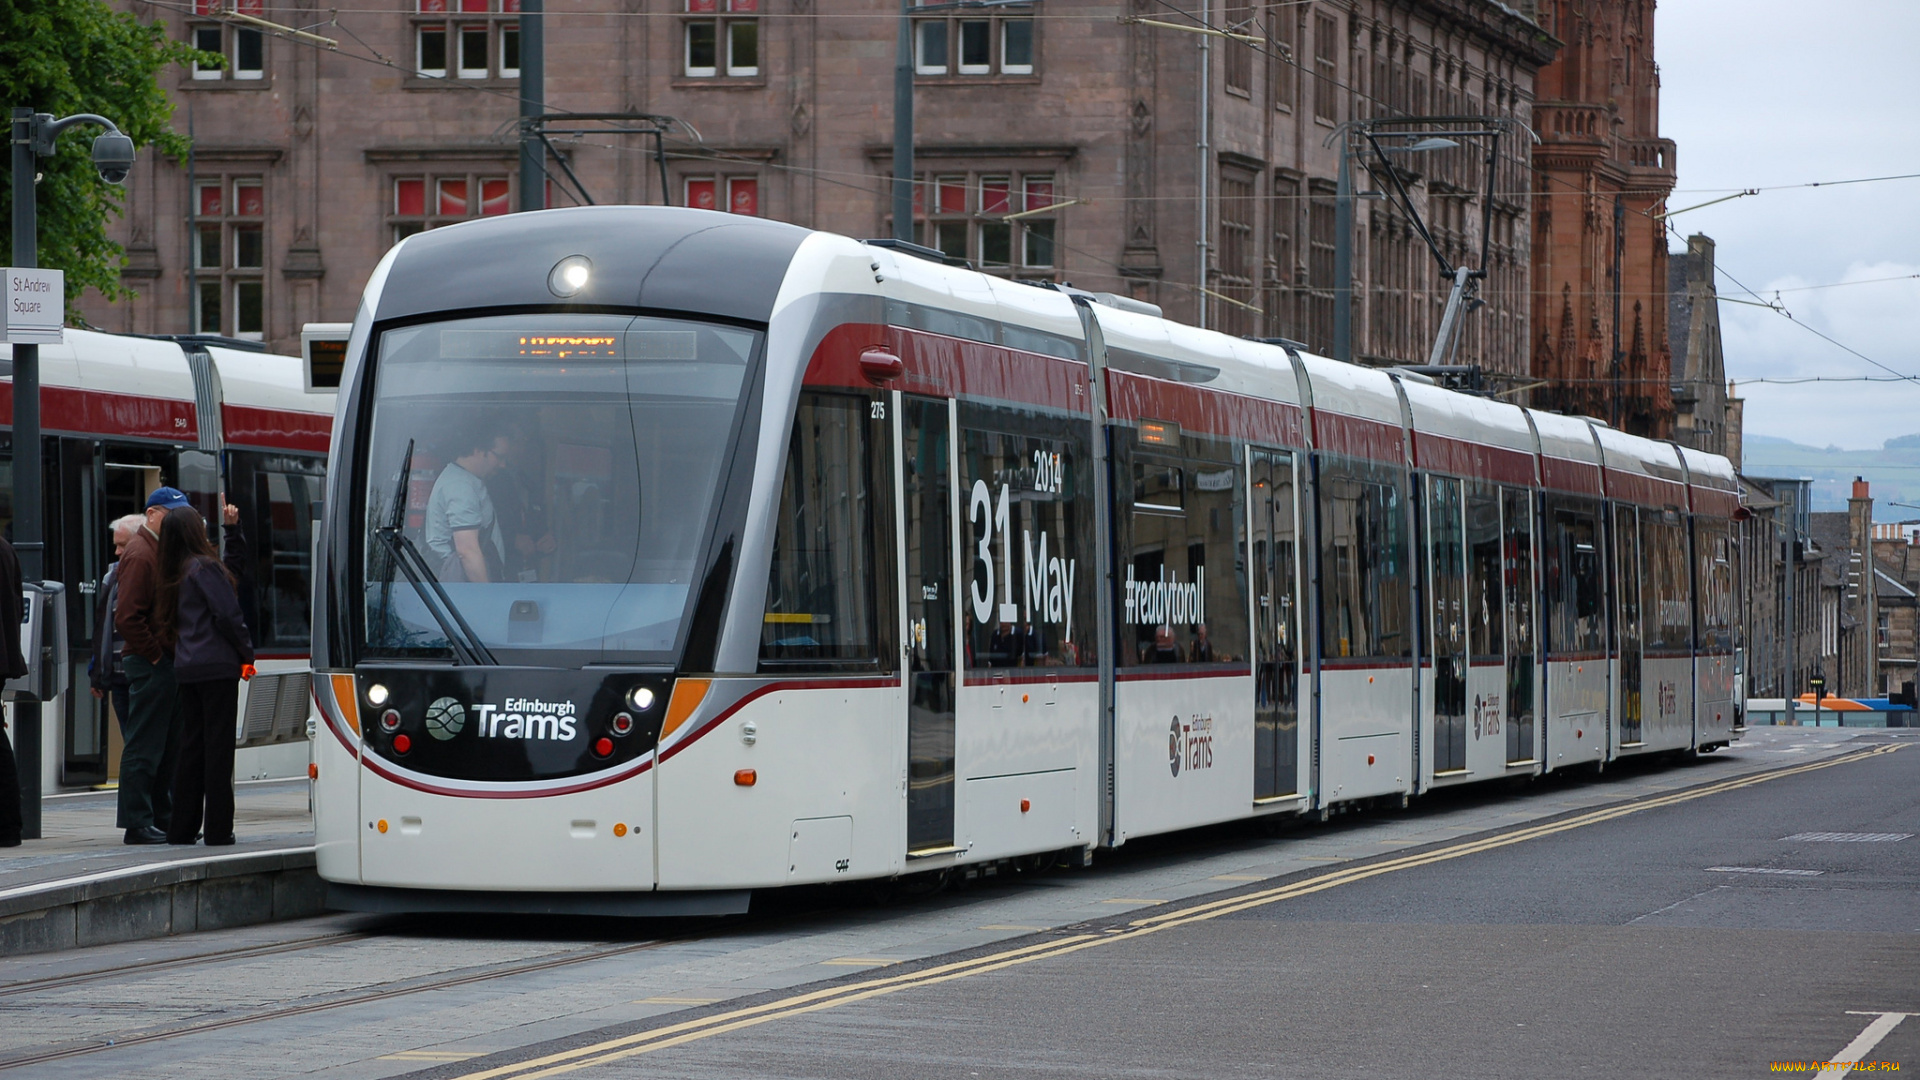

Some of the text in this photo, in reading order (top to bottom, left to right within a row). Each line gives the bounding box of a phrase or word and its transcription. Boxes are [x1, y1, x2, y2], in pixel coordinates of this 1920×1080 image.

[13, 277, 51, 292] St Andrew
[13, 297, 41, 315] Square
[870, 400, 885, 420] 275
[1034, 449, 1062, 494] 2014
[970, 479, 1075, 643] 31 May
[1125, 563, 1204, 638] #readytoroll
[471, 704, 577, 741] Trams
[505, 698, 575, 716] Edinburgh
[1192, 713, 1212, 734] Edinburgh
[1482, 700, 1500, 736] Trams
[1183, 724, 1213, 771] Trams
